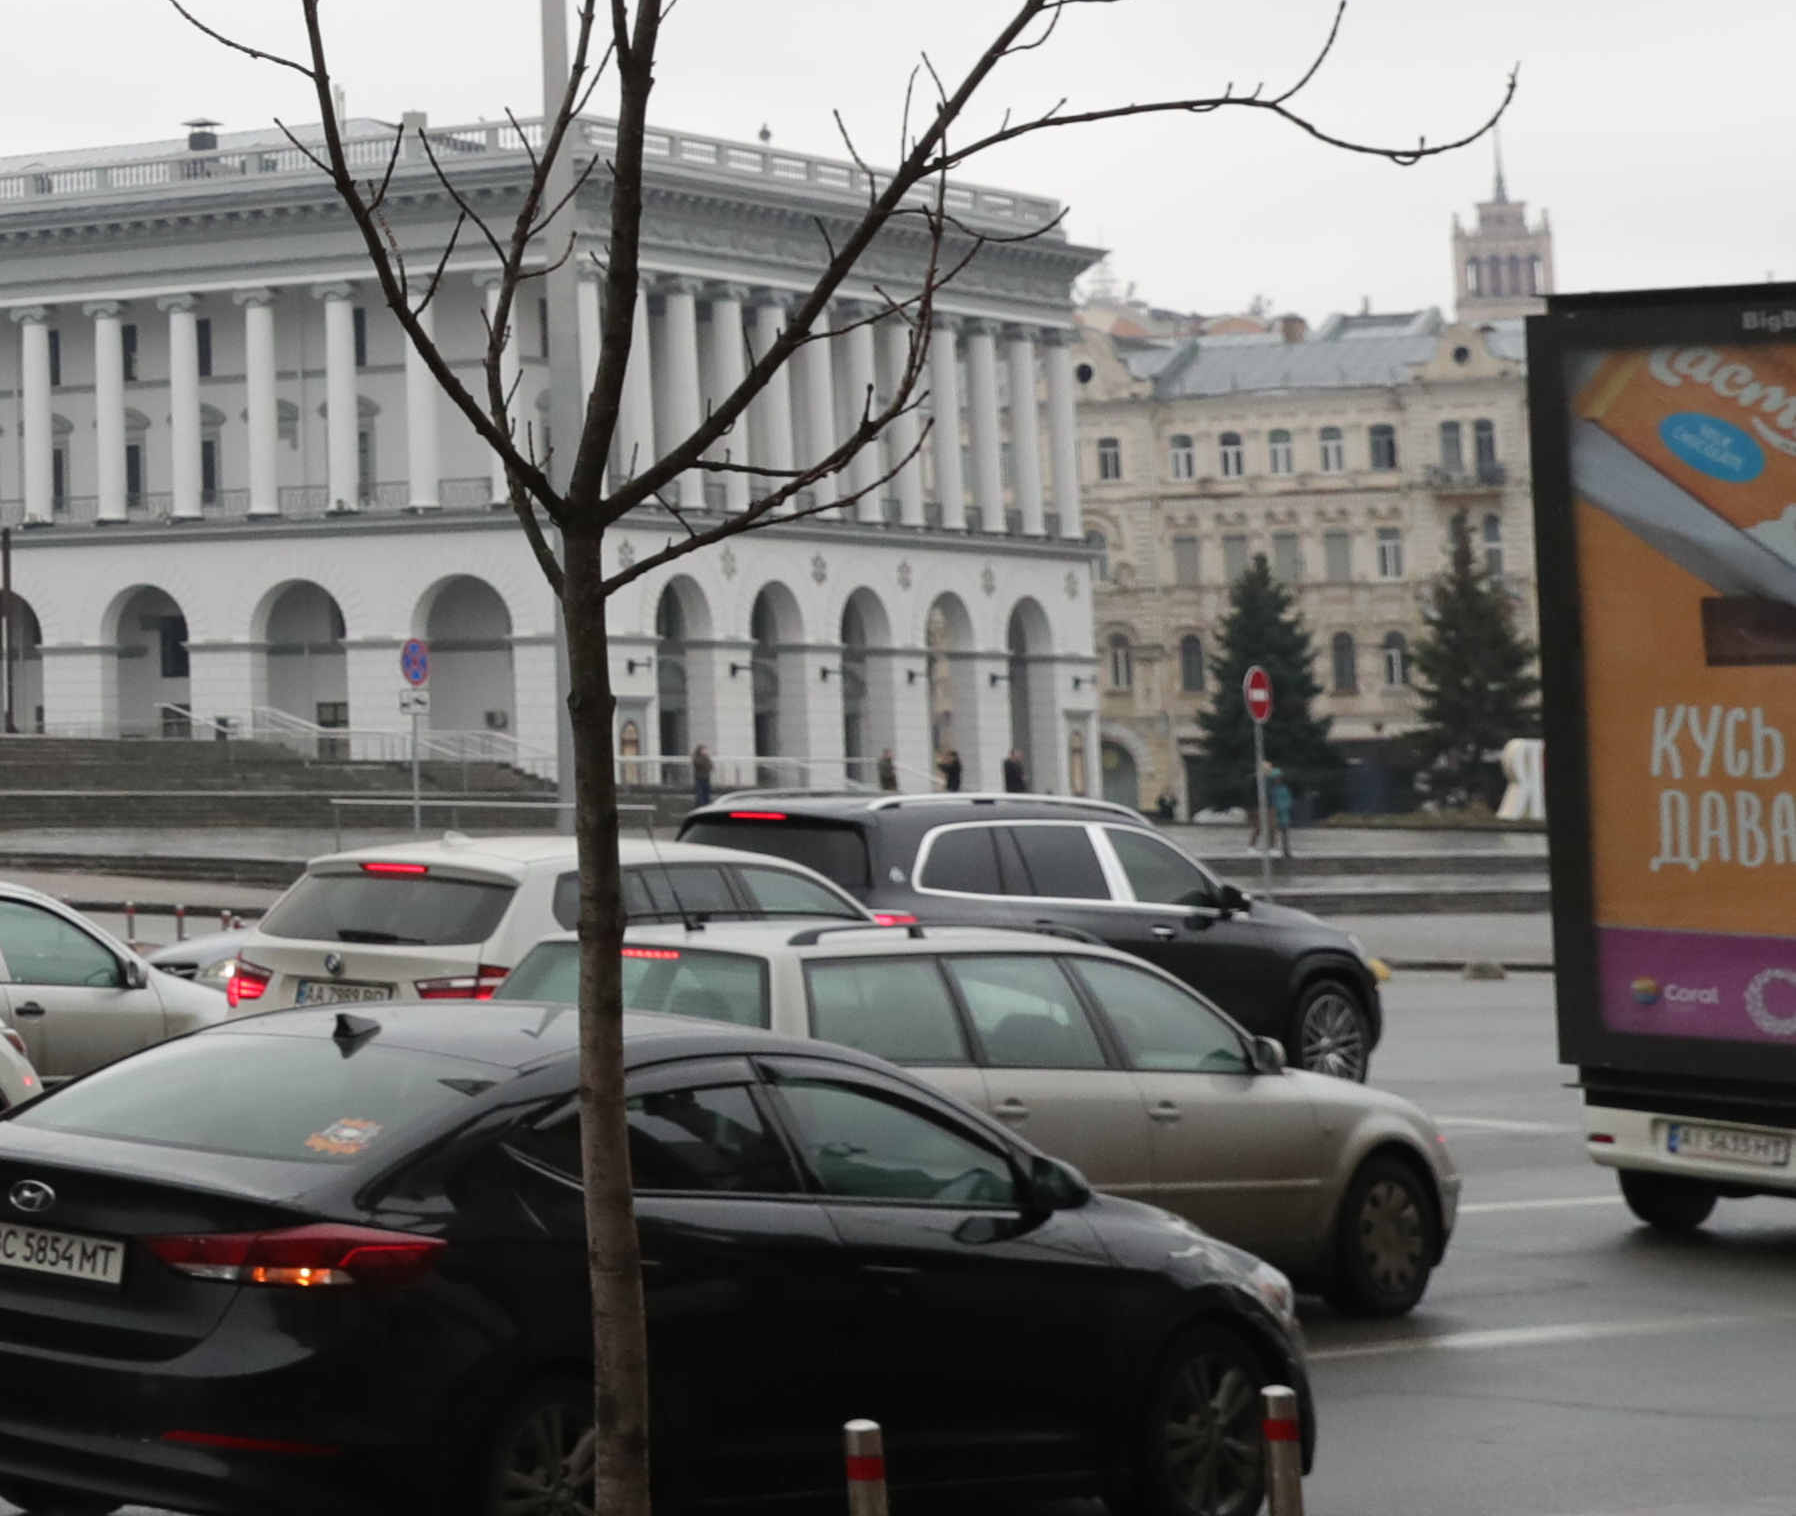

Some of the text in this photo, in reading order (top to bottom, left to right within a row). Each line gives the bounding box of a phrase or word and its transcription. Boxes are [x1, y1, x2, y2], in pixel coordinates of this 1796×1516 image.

[1650, 704, 1786, 779] КУСЬ
[1649, 789, 1796, 872] ДАВА
[1664, 984, 1720, 1004] Coral
[23, 1233, 74, 1269] 5854
[78, 1242, 117, 1277] MT
